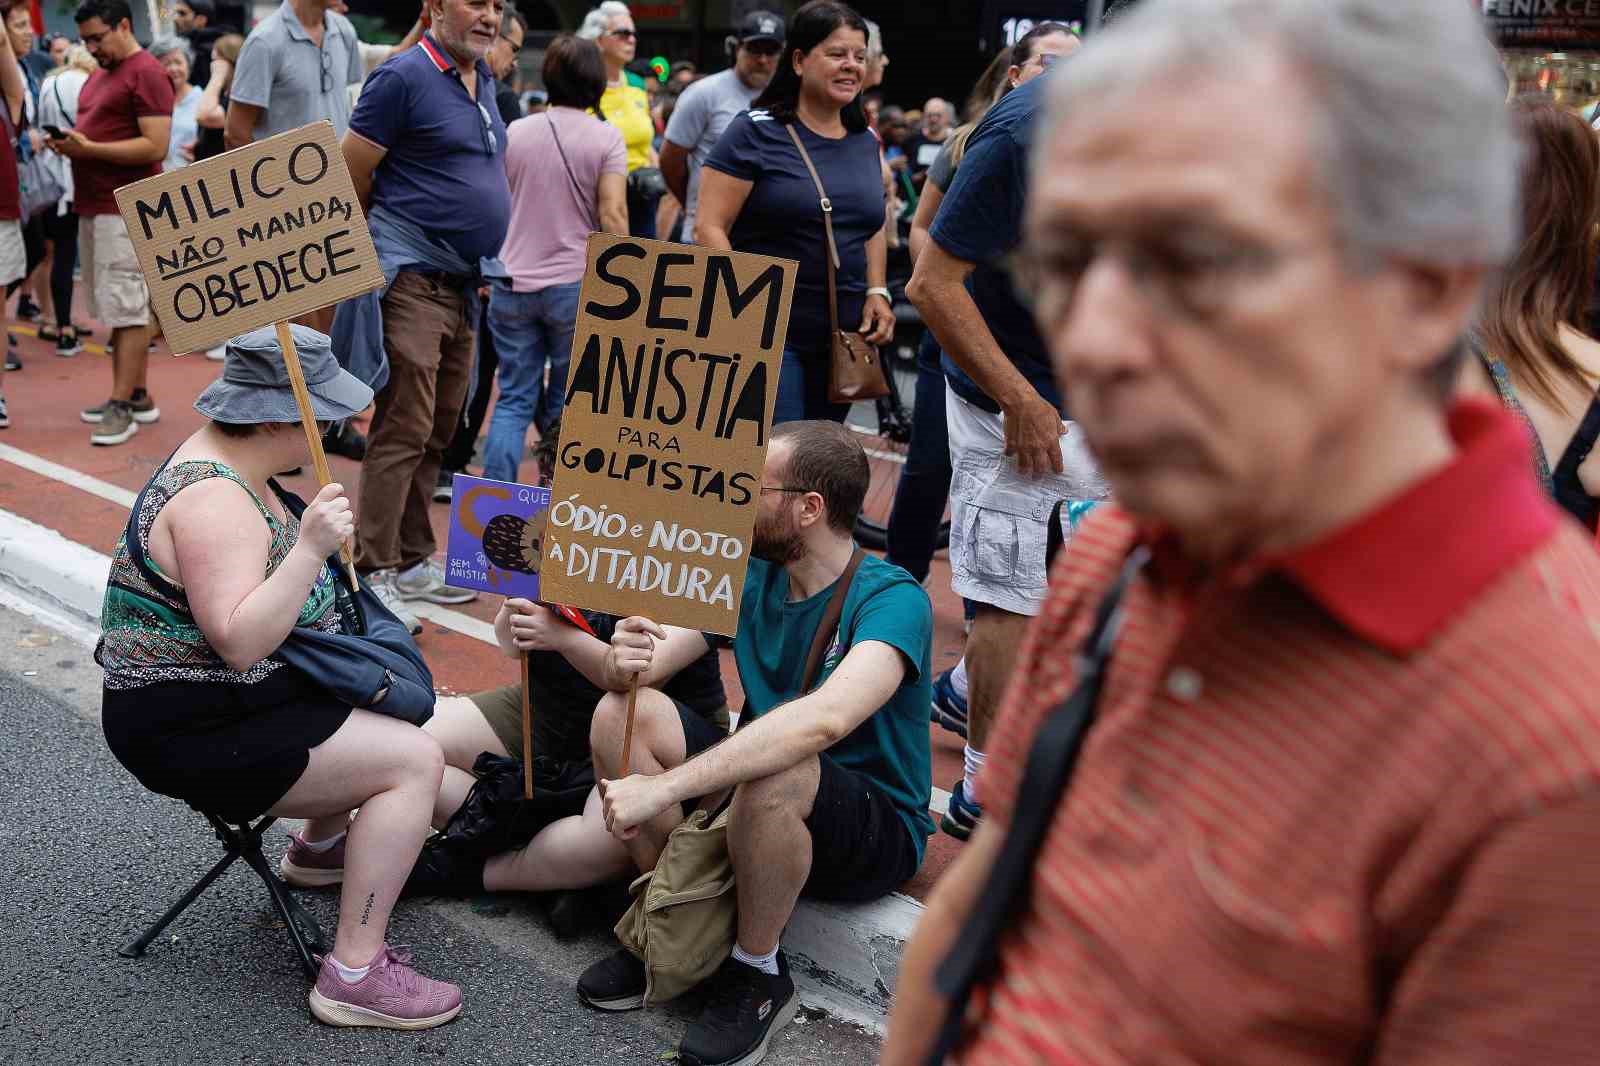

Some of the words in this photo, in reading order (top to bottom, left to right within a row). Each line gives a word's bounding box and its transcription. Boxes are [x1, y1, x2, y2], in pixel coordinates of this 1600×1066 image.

[135, 142, 329, 240] MILICO
[155, 236, 225, 274] NÃO
[237, 196, 352, 248] MANDA,
[173, 230, 361, 323] OBEDECE
[585, 243, 785, 350] SEM
[617, 426, 681, 454] PARA
[518, 488, 551, 505] QUE
[560, 441, 757, 506] GOLPISTAS
[450, 558, 470, 569] SEM
[648, 520, 743, 560] NOJO
[450, 567, 488, 584] ANISTIA
[566, 542, 735, 610] DITADURA
